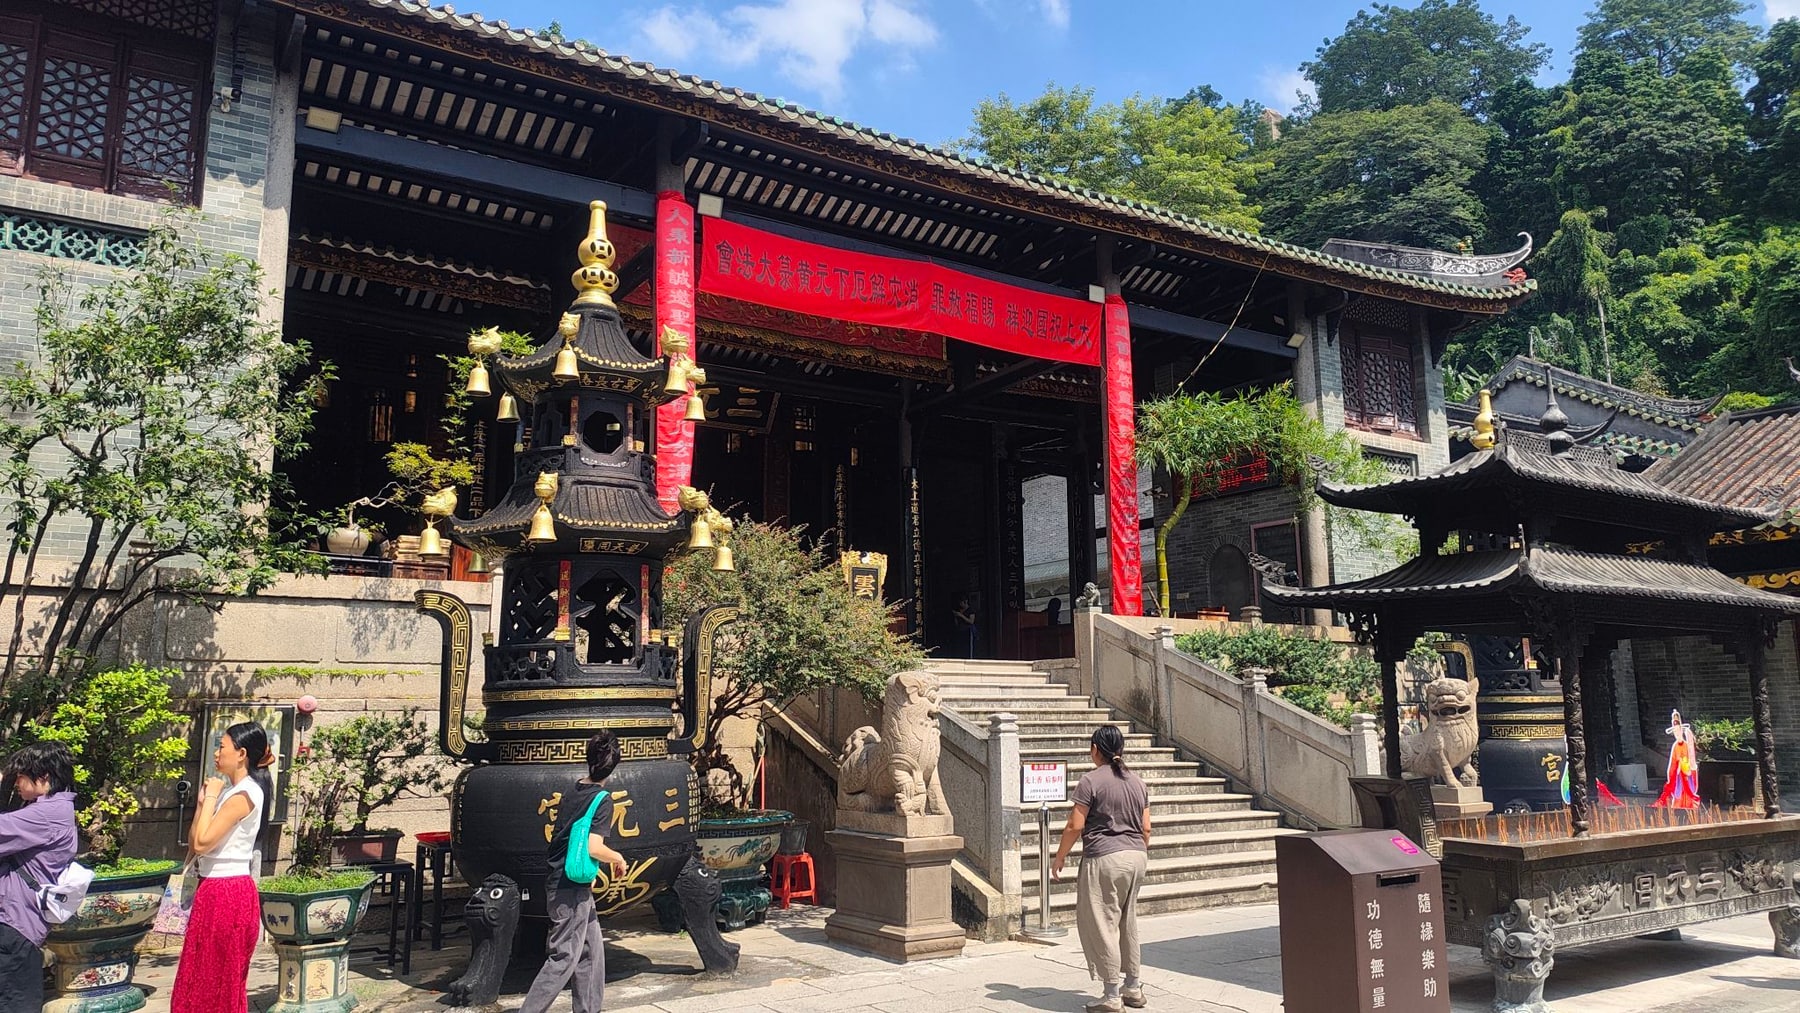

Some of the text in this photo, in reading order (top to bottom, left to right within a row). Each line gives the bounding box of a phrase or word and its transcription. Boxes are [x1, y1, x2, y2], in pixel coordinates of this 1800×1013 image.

[1366, 899, 1386, 1009] 功德無量
[1417, 893, 1437, 998] 隨緣樂助
